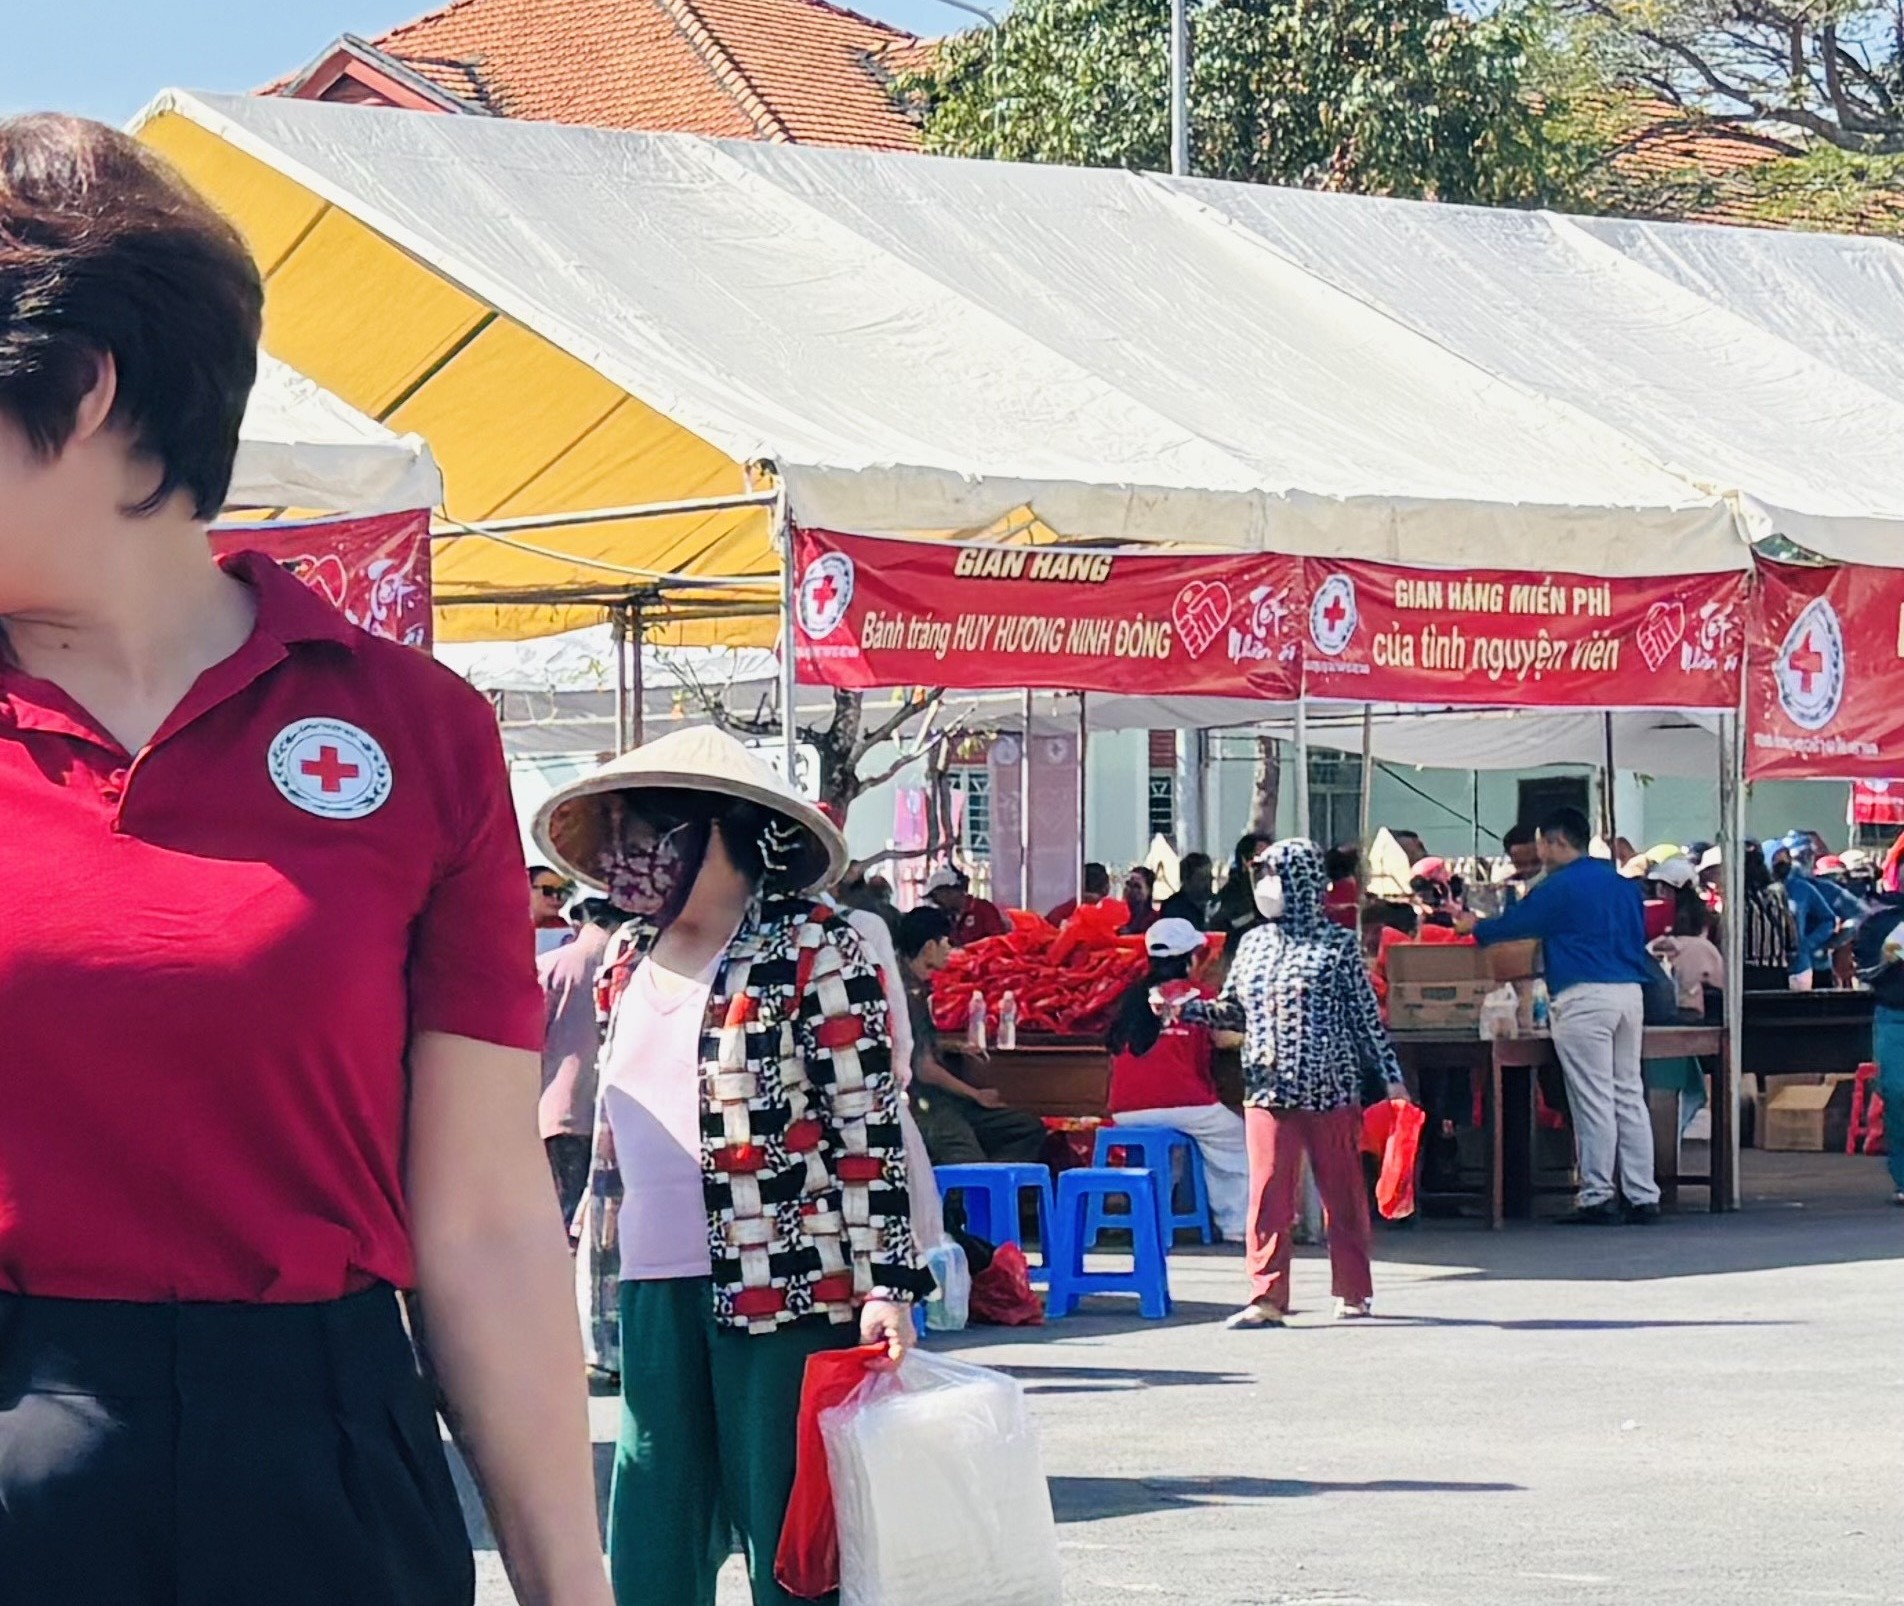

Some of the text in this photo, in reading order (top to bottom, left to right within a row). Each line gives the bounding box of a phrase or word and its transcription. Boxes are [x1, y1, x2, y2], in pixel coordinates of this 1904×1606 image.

[954, 548, 1026, 578] GIAN
[1395, 579, 1443, 611] GIAN
[861, 611, 905, 650] Bánh
[907, 611, 951, 660] tráng
[952, 613, 996, 652] HUY
[993, 614, 1065, 654] HƯƠNG
[1066, 617, 1114, 656] NINH
[1373, 620, 1414, 668] của
[1421, 623, 1466, 669] tình
[1472, 628, 1568, 681] nguyện
